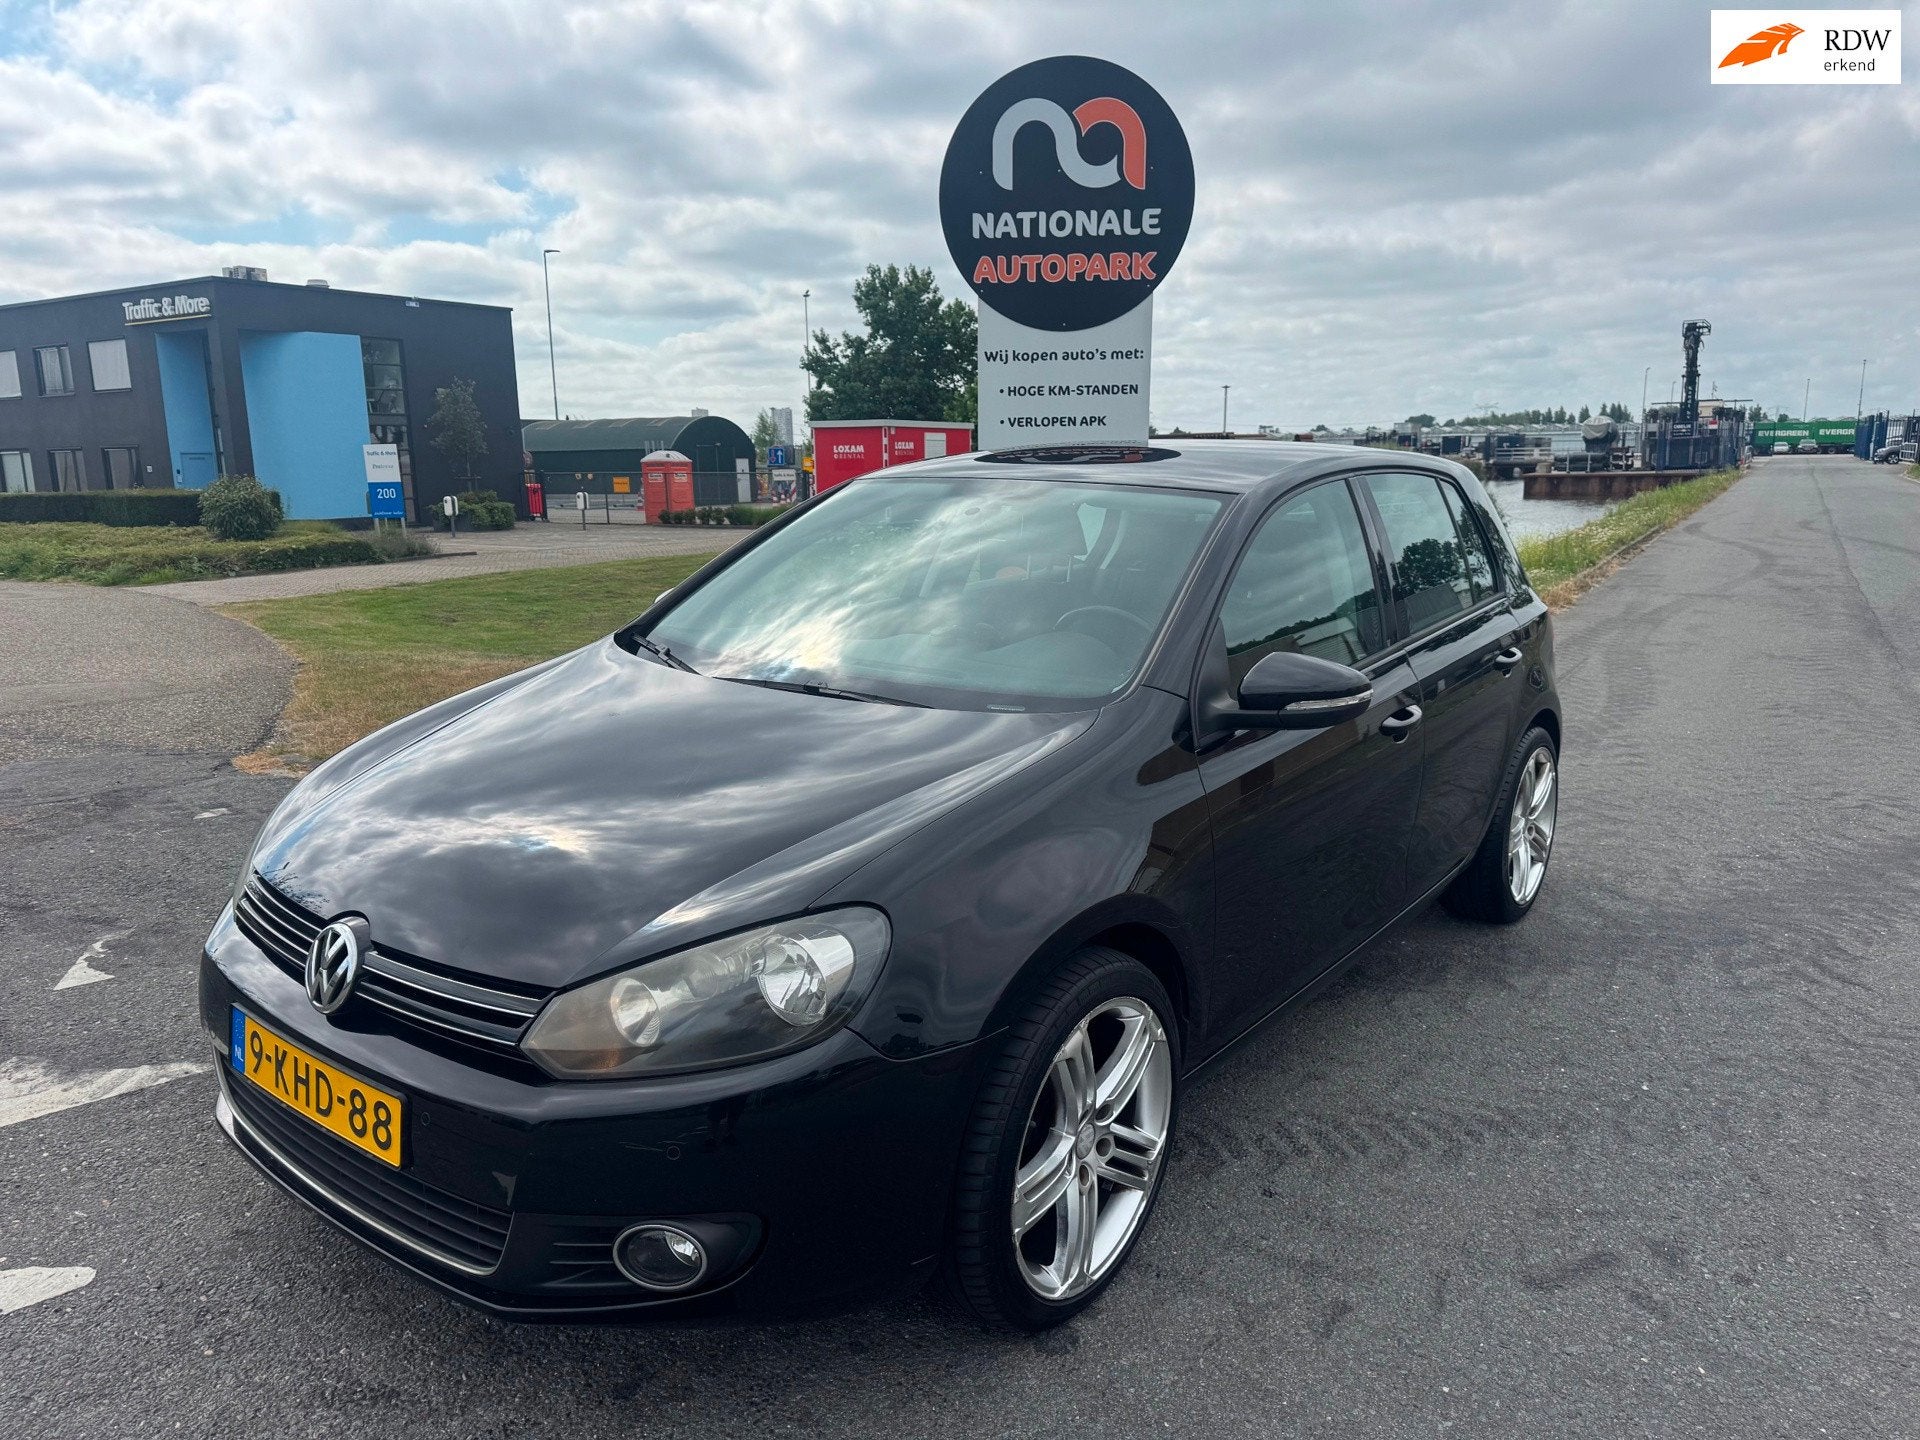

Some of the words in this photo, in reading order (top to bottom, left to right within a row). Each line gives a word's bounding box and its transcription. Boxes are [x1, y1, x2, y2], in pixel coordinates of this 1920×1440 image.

[972, 208, 1162, 239] NATIONALE
[973, 252, 1157, 284] AUTOPARK
[122, 298, 162, 321] Traffic
[162, 297, 175, 316] &
[175, 295, 211, 314] More
[984, 350, 1009, 365] Wij
[1012, 350, 1058, 363] kopen
[1062, 348, 1107, 361] auto's
[1110, 348, 1144, 360] met:
[1007, 385, 1045, 397] HOGE
[1048, 384, 1139, 396] KM-STANDEN
[1008, 416, 1077, 428] VERLOPEN
[1079, 415, 1107, 427] APK
[1758, 429, 1810, 437] EVERGREEN
[833, 444, 865, 453] LOXAM
[894, 441, 914, 450] LOXAM
[377, 488, 396, 499] 200
[234, 1043, 244, 1063] NL
[249, 1029, 393, 1151] 9-KHD-88
